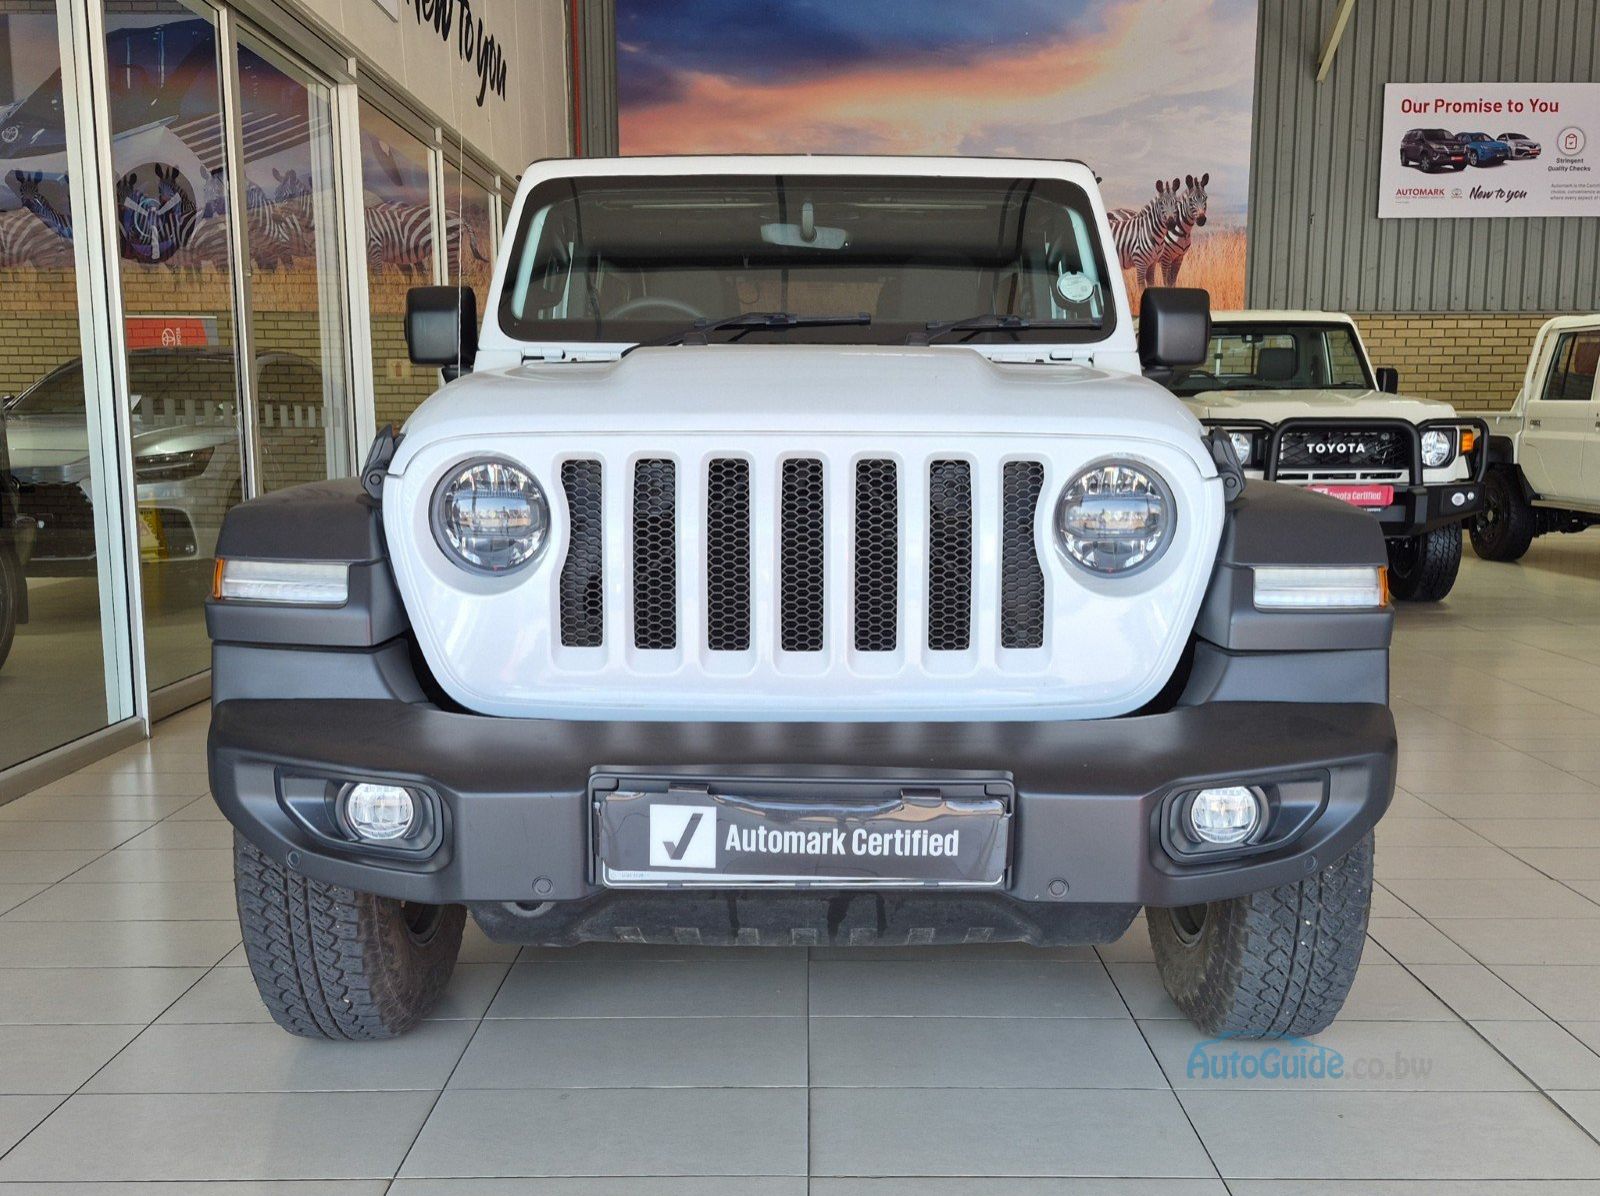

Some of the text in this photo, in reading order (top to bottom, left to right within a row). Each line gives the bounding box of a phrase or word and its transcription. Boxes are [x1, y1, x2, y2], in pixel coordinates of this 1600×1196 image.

[475, 17, 507, 108] you
[1401, 98, 1560, 114] Our Promise to You
[1395, 188, 1445, 196] AUTOMARK
[1469, 184, 1494, 200] New
[1504, 189, 1528, 203] you
[1306, 442, 1366, 454] TOYOTA
[724, 823, 960, 857] Automark Certified
